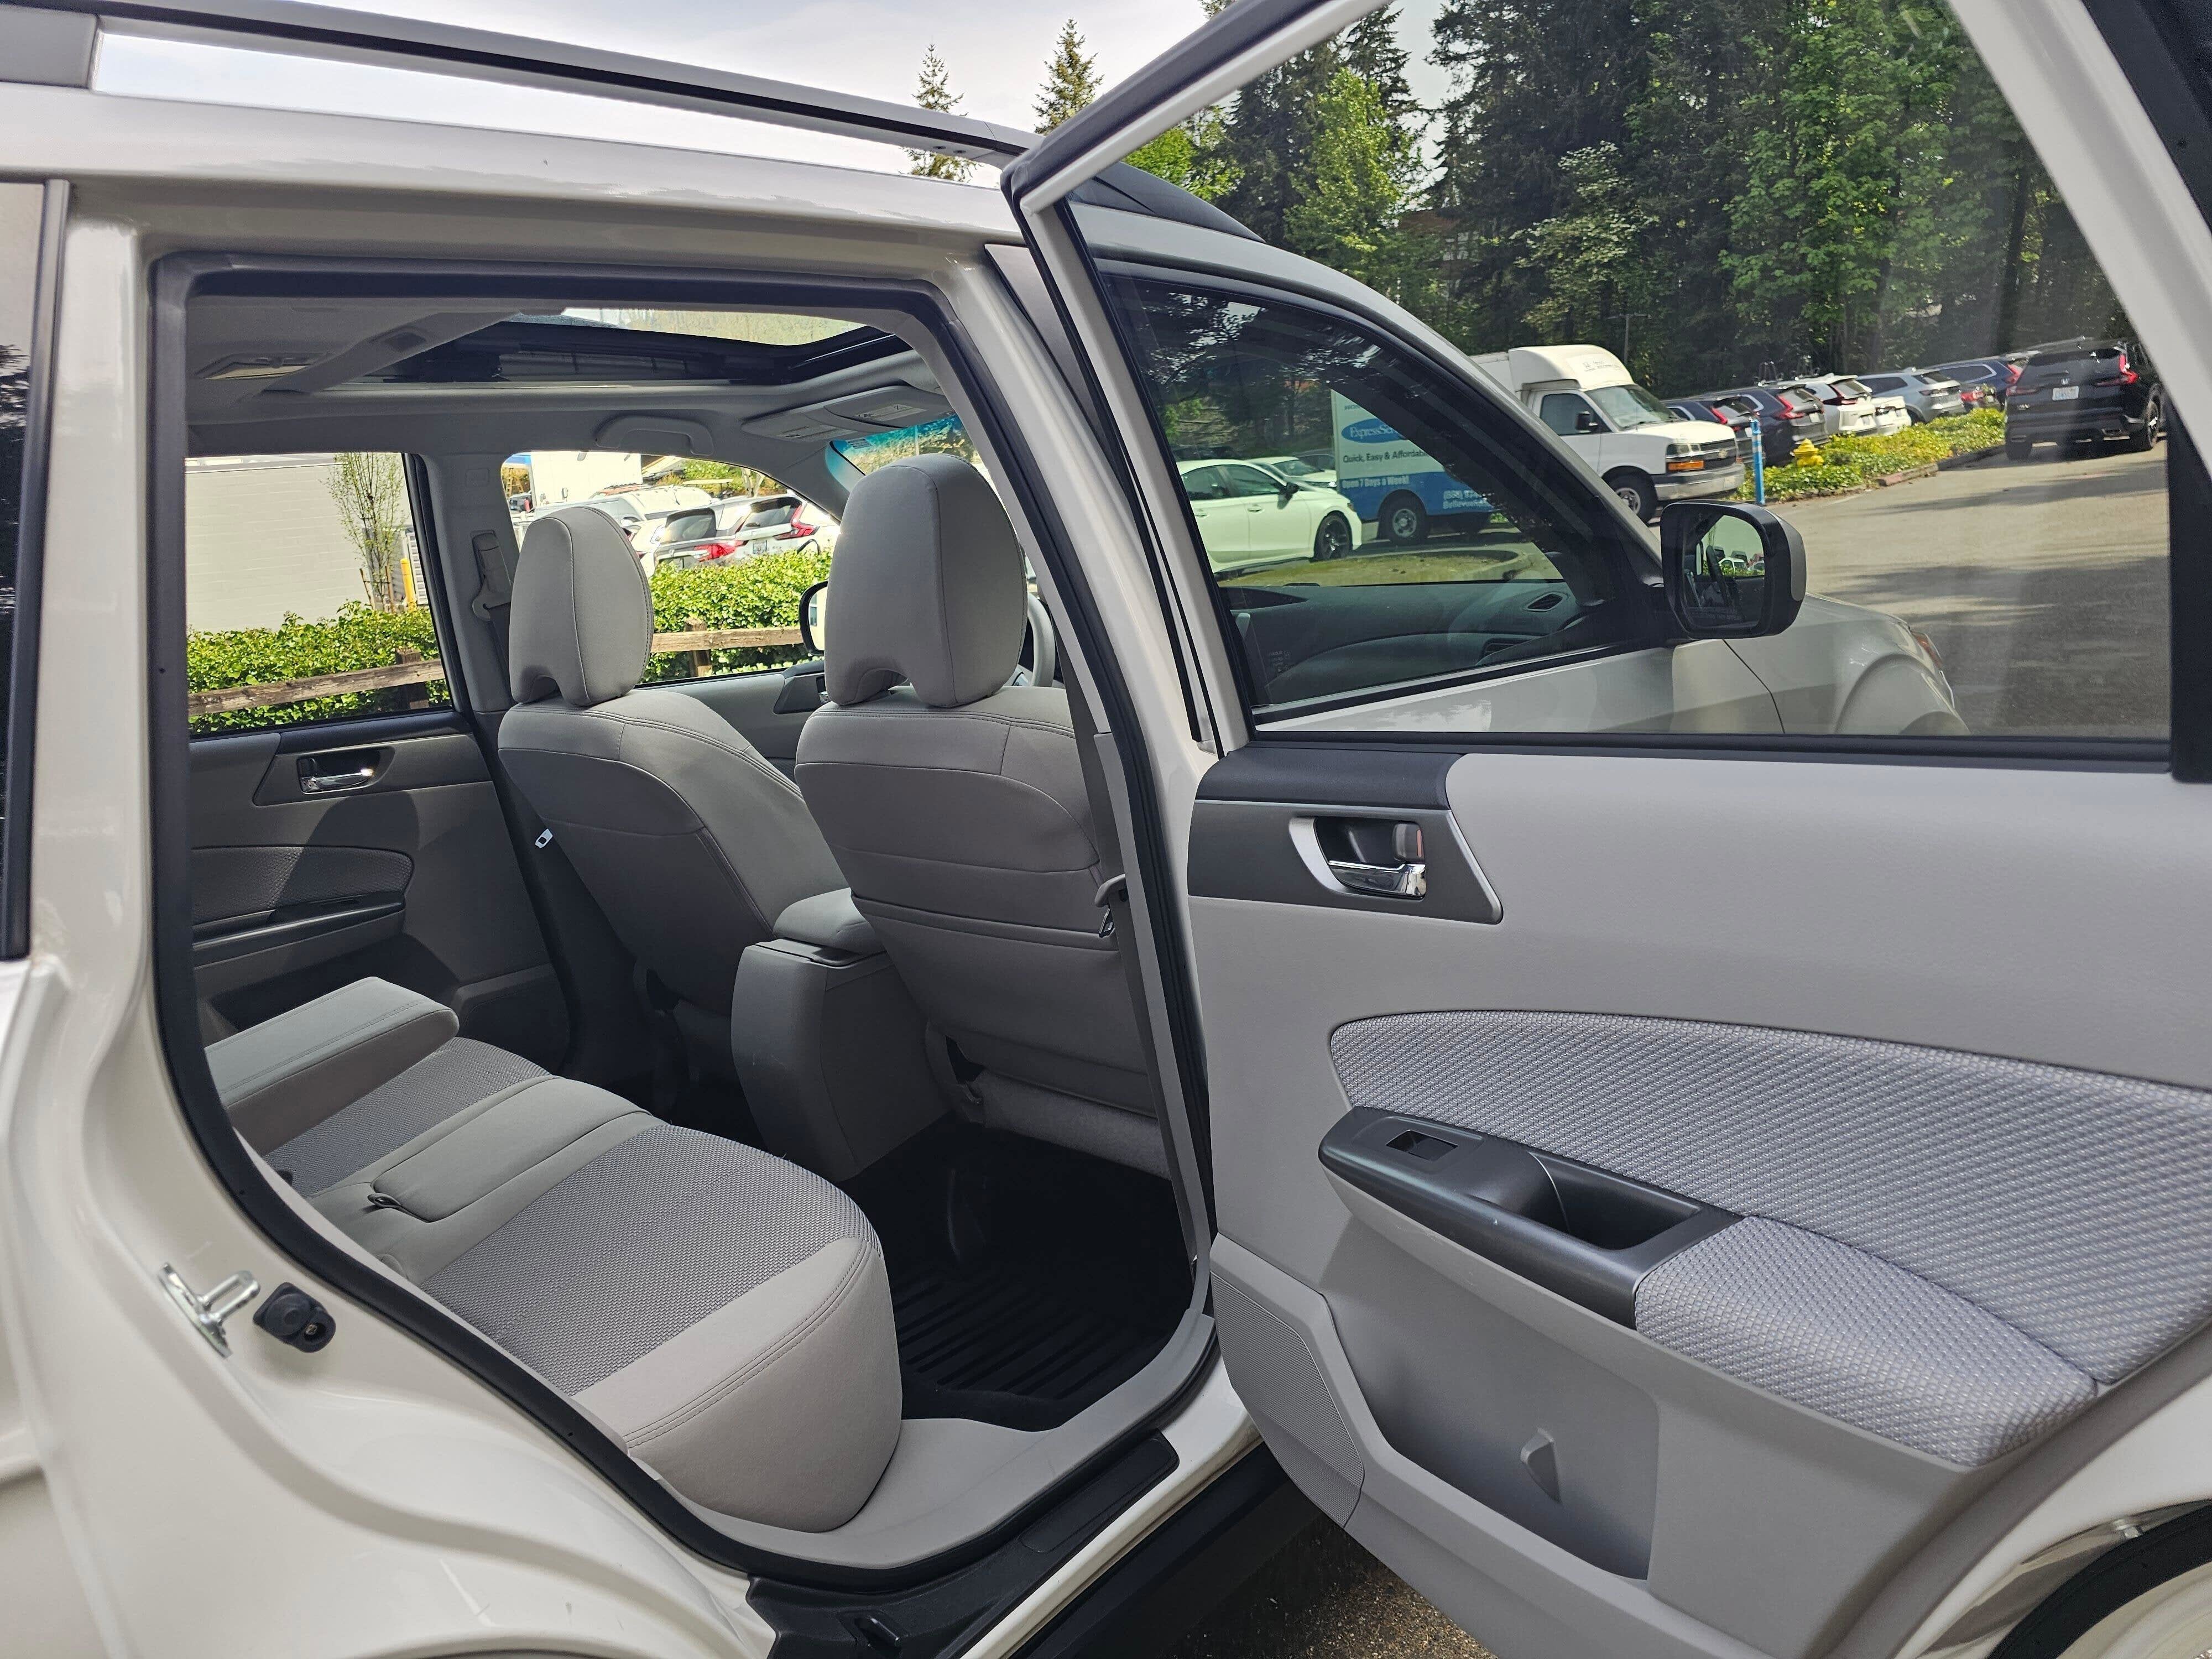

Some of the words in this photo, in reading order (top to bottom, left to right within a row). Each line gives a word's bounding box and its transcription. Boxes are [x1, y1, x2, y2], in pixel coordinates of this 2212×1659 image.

[1343, 454, 1364, 463] Quick,
[1366, 453, 1383, 462] Easy
[1384, 451, 1391, 460] &
